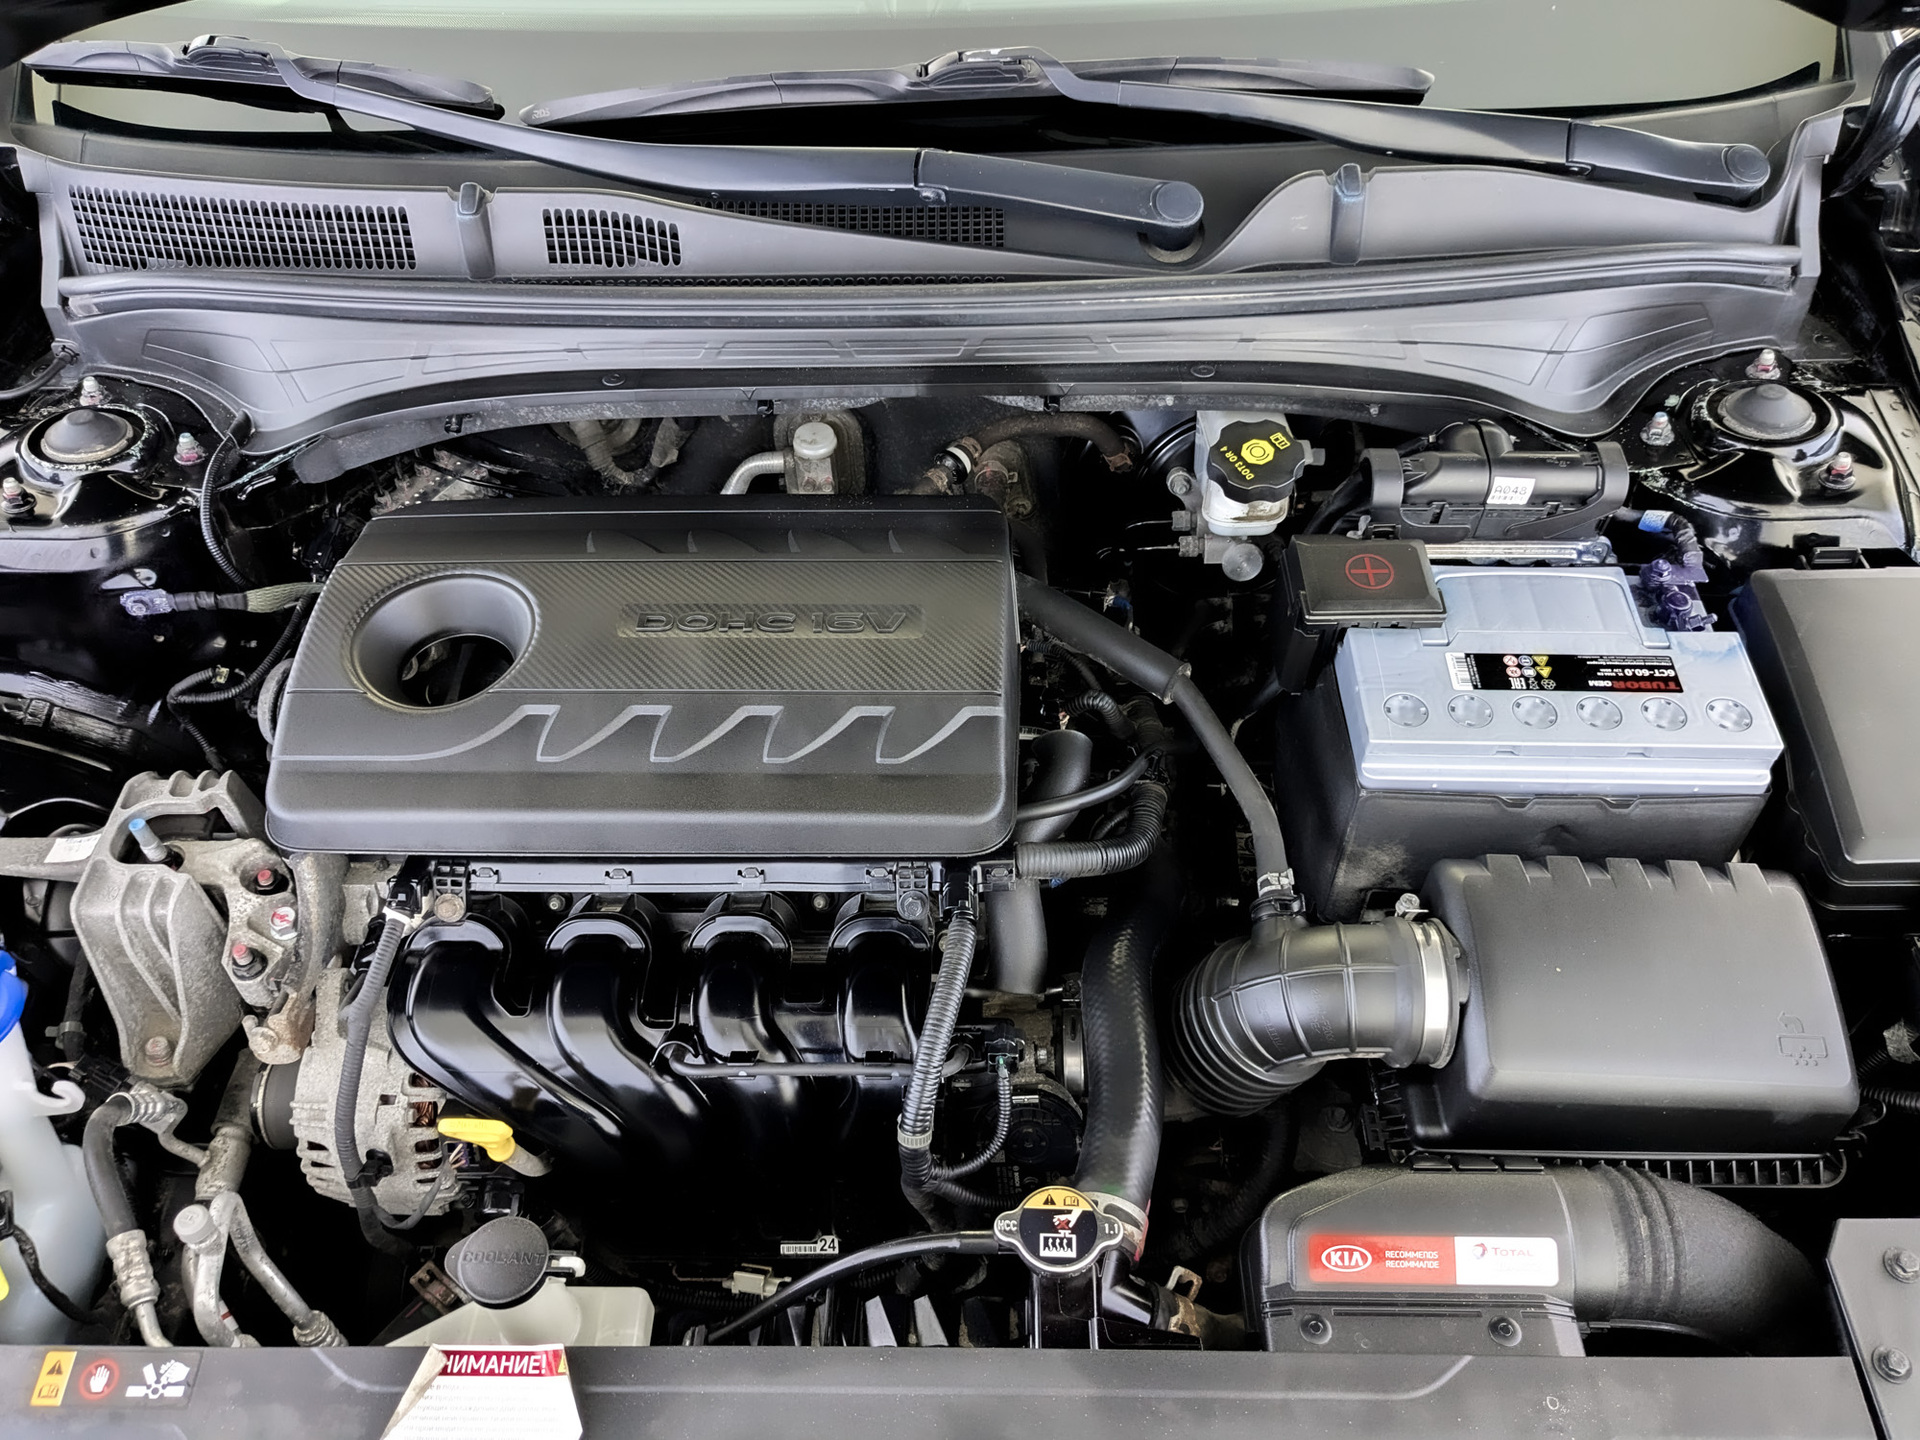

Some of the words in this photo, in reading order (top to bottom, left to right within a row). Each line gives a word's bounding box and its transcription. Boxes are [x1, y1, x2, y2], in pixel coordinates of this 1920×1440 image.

[1225, 450, 1238, 463] OR
[1234, 461, 1255, 480] DOT3
[1494, 485, 1528, 496] A048
[635, 611, 796, 633] DOHC
[811, 611, 907, 634] 16V
[1588, 679, 1612, 687] OEM
[1612, 680, 1681, 690] TUBOR
[998, 1219, 1018, 1232] HCC
[1104, 1223, 1119, 1234] 1.1
[819, 1238, 836, 1252] 24
[1385, 1250, 1439, 1260] RECOMMENDS
[1491, 1247, 1534, 1257] TOTAL
[462, 1251, 545, 1266] COOLANT
[1385, 1260, 1440, 1269] RECOMMANDE
[446, 1354, 547, 1375] НИМАНИЕ!
